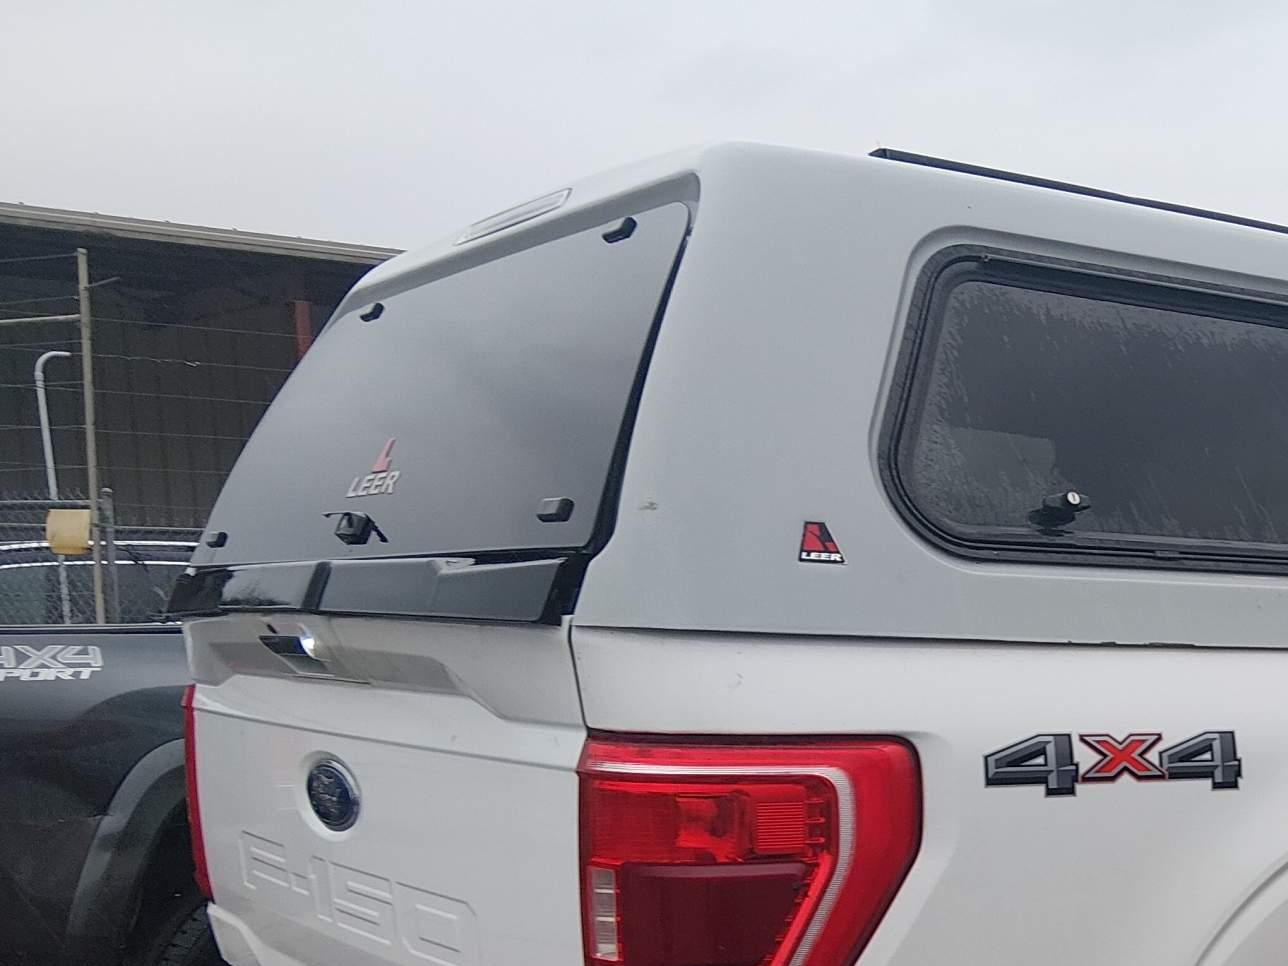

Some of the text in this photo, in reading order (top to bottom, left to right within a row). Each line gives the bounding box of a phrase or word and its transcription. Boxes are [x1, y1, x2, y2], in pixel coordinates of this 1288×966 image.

[344, 470, 401, 498] LEER
[800, 551, 842, 561] LEER
[0, 667, 102, 681] PORT
[984, 731, 1242, 797] 4X4
